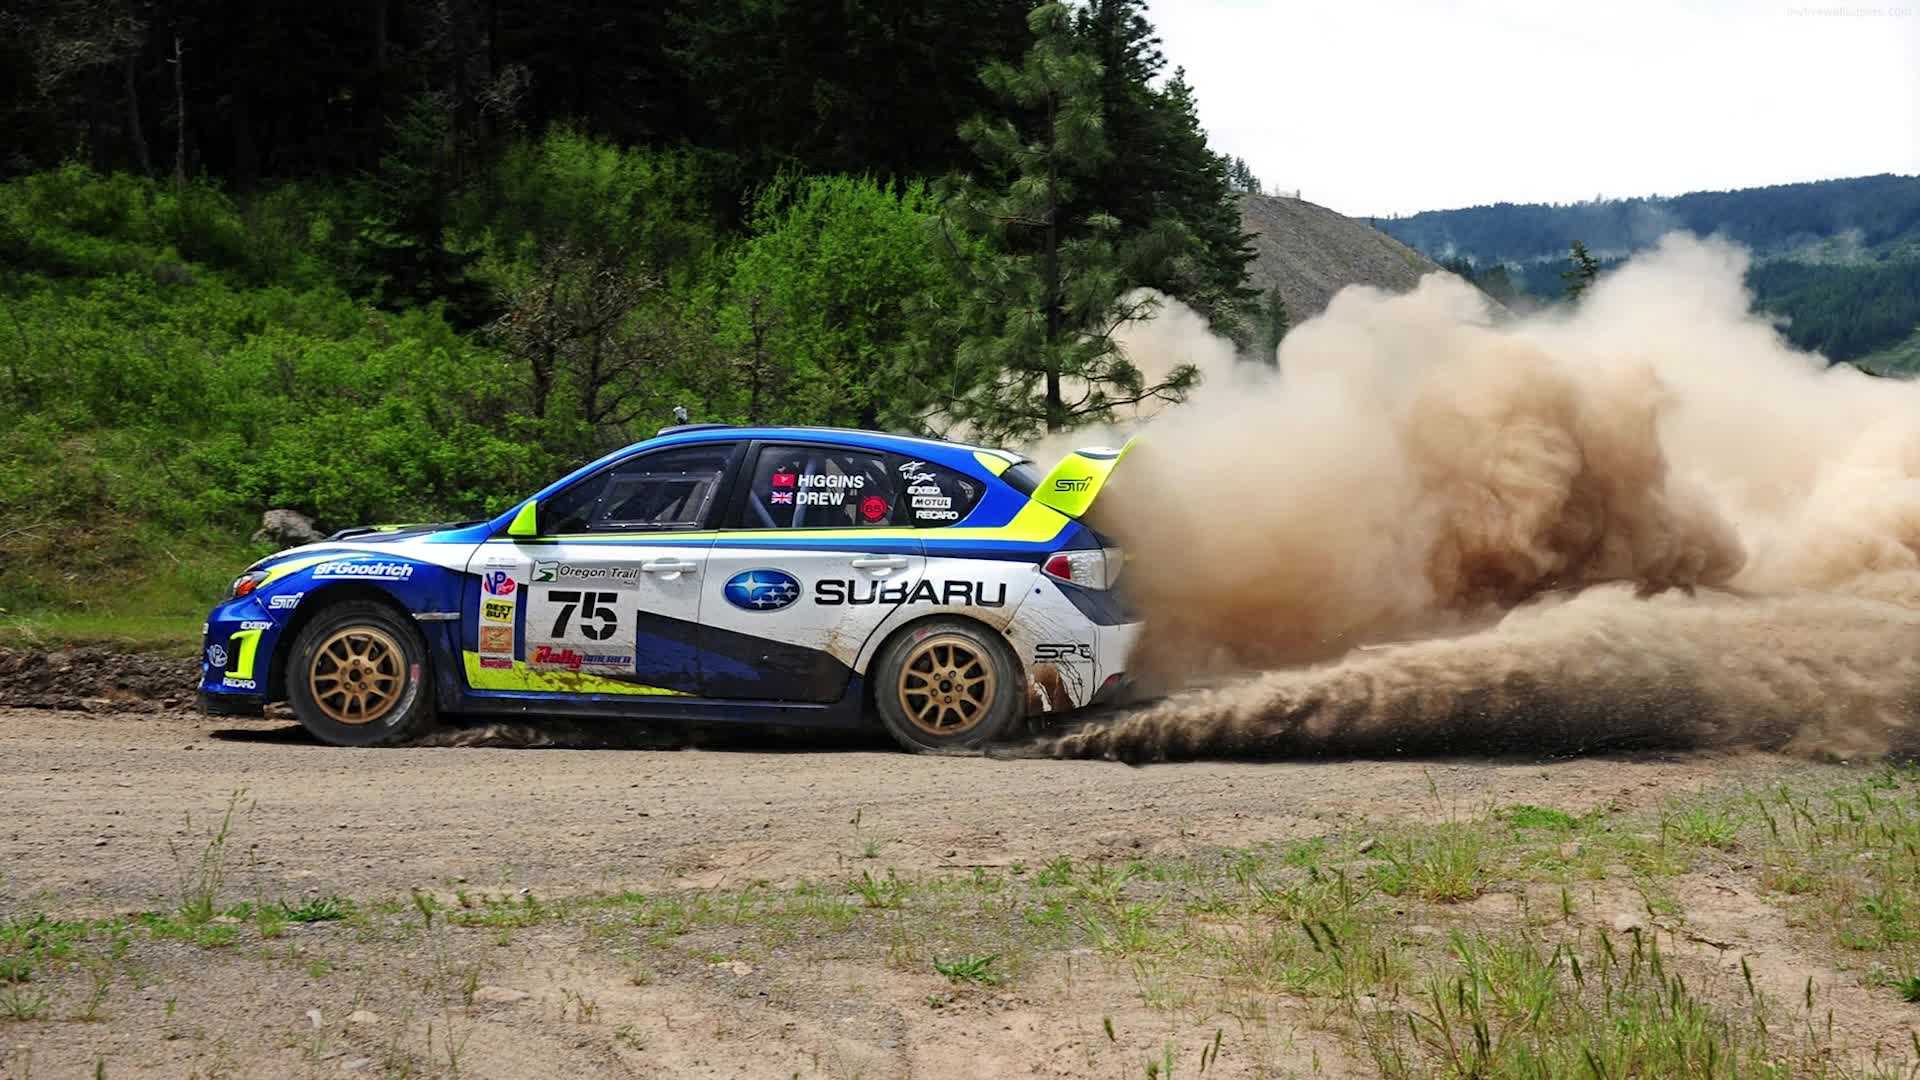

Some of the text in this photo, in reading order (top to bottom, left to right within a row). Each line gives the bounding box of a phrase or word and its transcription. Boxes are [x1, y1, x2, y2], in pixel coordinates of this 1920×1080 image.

[797, 474, 865, 489] HIGGINS
[796, 491, 845, 506] DREW
[914, 498, 948, 506] MOTUL
[915, 510, 959, 520] RECARO
[313, 561, 414, 578] BFGoodrich
[560, 565, 638, 579] Oregon Trail
[485, 571, 506, 595] VP
[814, 580, 1007, 607] SUBARU
[486, 603, 513, 611] BEST
[486, 611, 509, 619] BUY
[548, 590, 618, 640] 75
[240, 621, 273, 630] EXEDY
[535, 645, 583, 669] Rally
[222, 677, 256, 689] RECARO
